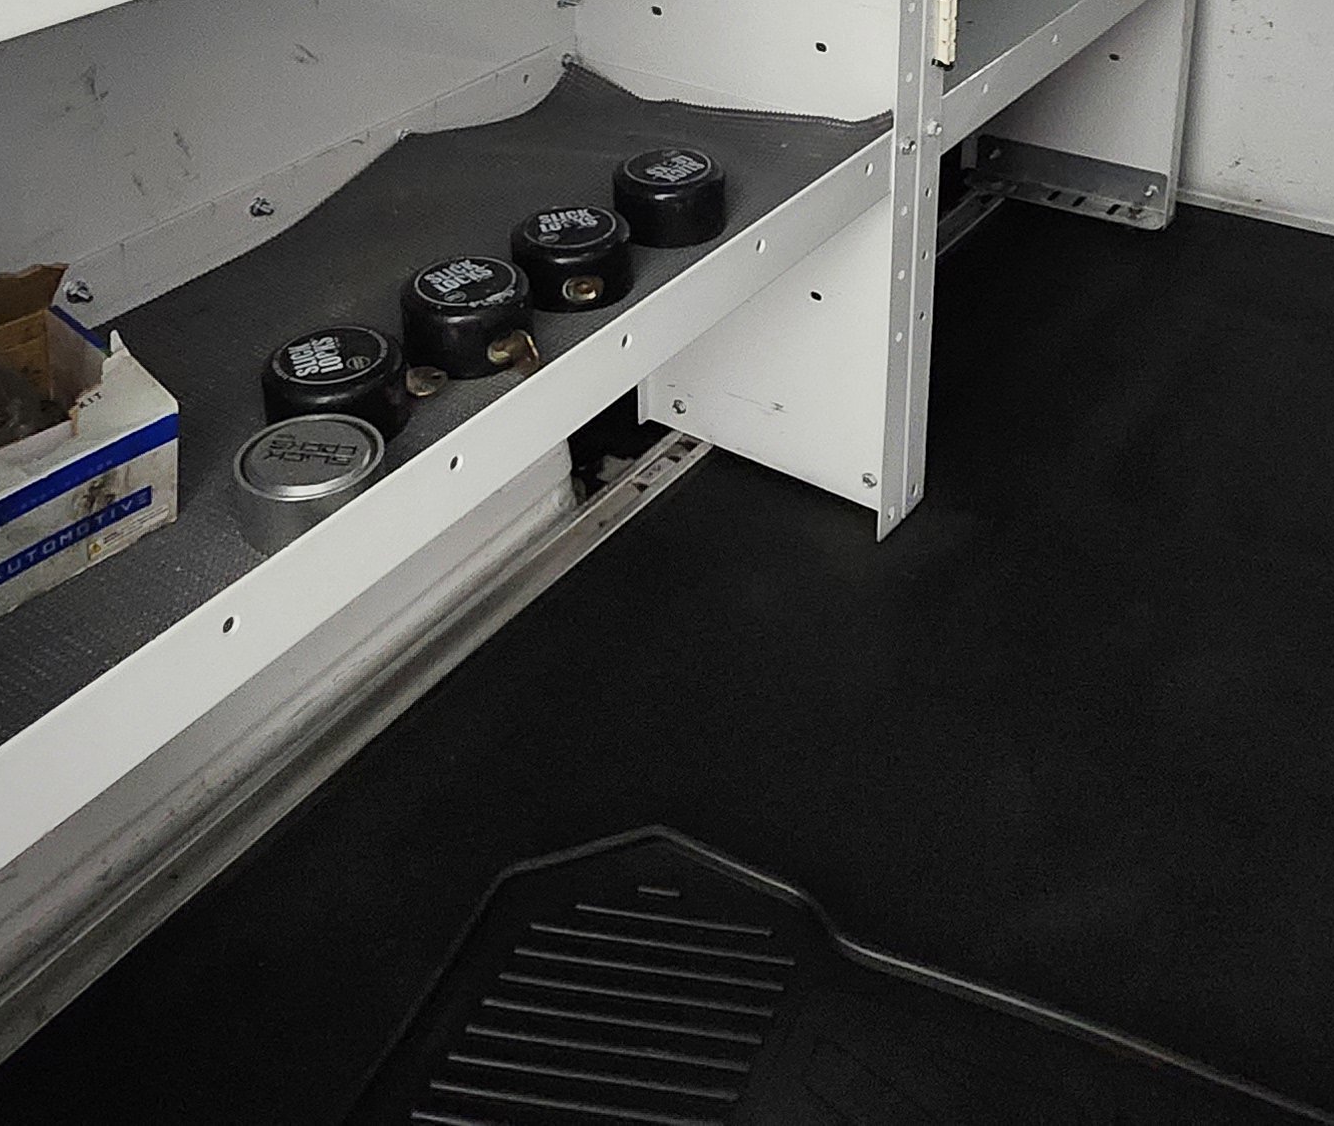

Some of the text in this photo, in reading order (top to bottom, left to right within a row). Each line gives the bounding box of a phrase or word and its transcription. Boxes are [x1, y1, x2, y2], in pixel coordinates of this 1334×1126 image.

[538, 208, 592, 225] SLICK
[423, 259, 473, 284] SLICK
[432, 266, 493, 293] LOCKS
[287, 342, 320, 377] SLICK
[312, 336, 344, 374] LOCKS
